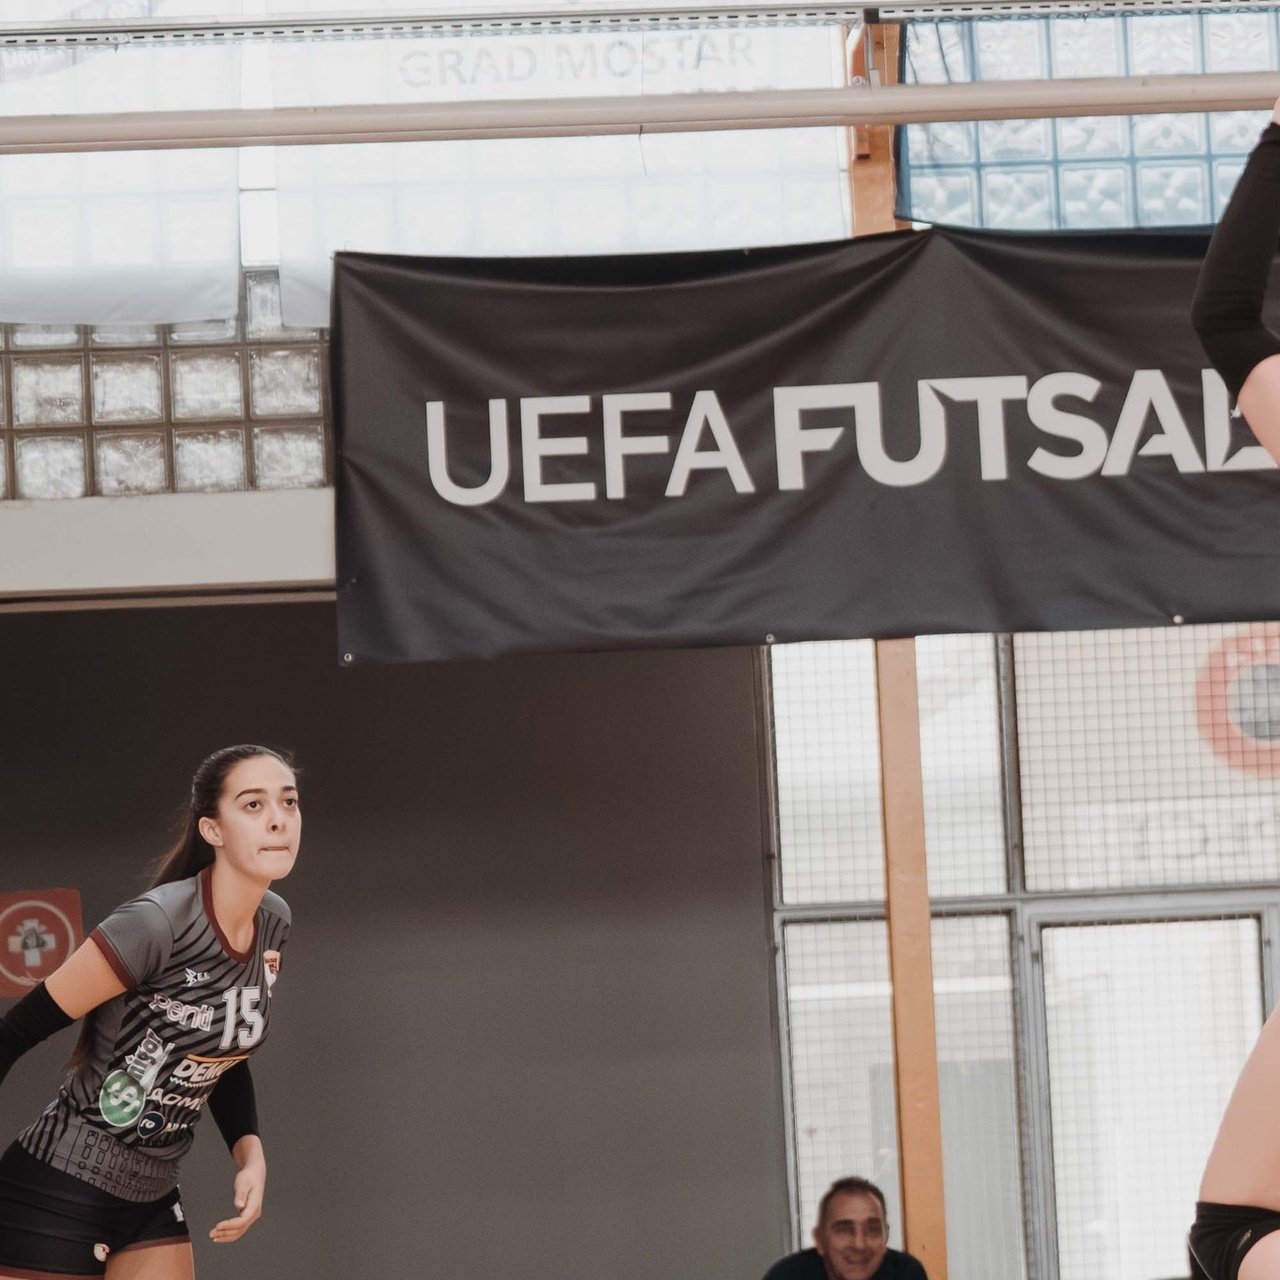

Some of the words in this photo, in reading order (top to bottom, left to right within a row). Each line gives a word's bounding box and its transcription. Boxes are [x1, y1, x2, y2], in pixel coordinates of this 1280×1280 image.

[400, 41, 538, 88] GRAD
[554, 31, 756, 80] MOSTAR
[426, 389, 756, 507] UEFA
[772, 368, 1279, 491] FUTSAL
[218, 985, 264, 1050] 15
